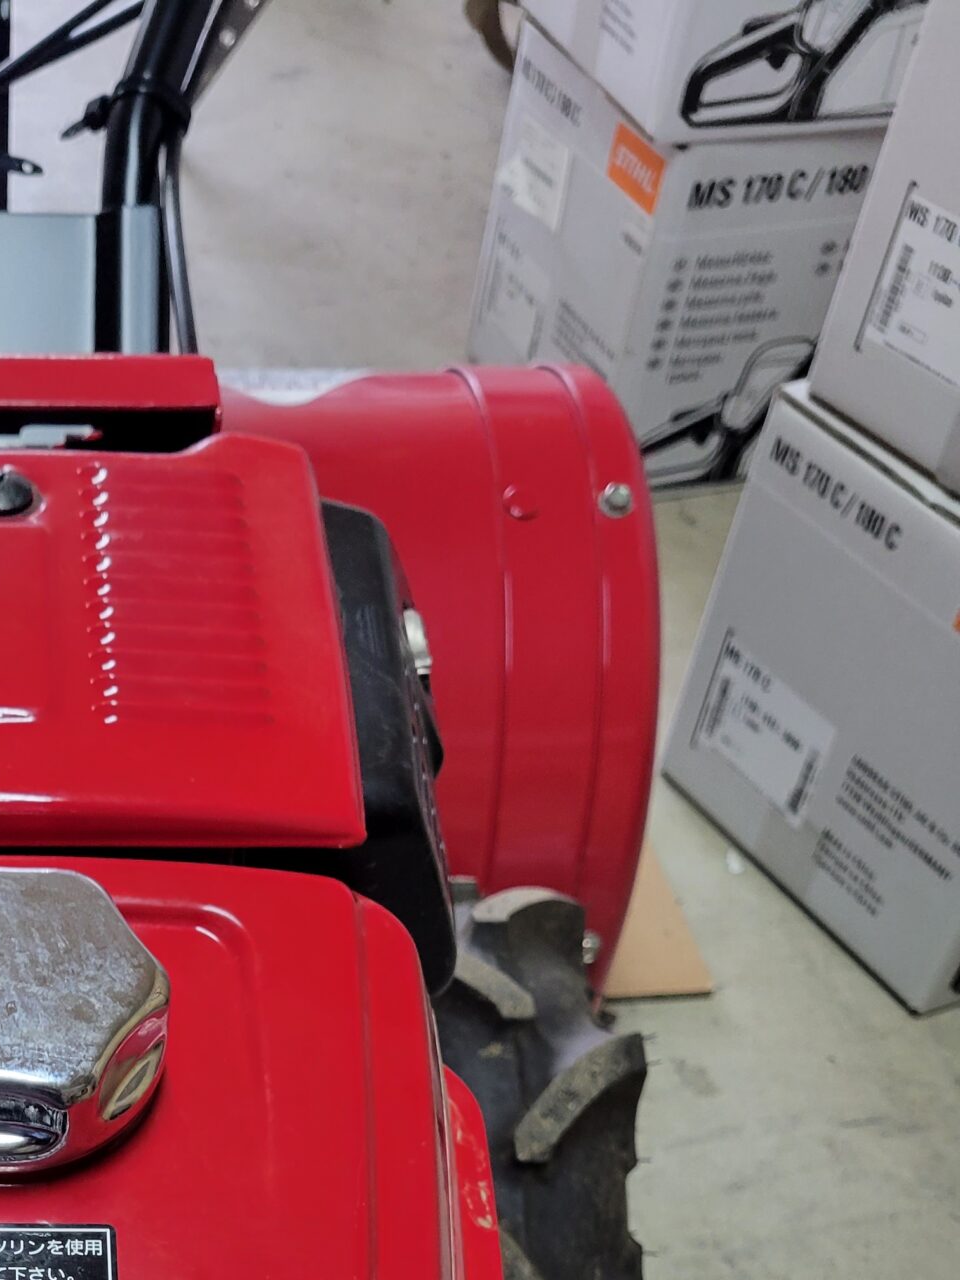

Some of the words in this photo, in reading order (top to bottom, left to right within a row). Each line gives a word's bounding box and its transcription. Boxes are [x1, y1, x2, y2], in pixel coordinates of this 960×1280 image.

[688, 178, 736, 210] MS
[742, 173, 784, 205] 170
[770, 435, 802, 476] MS
[803, 461, 831, 500] 170
